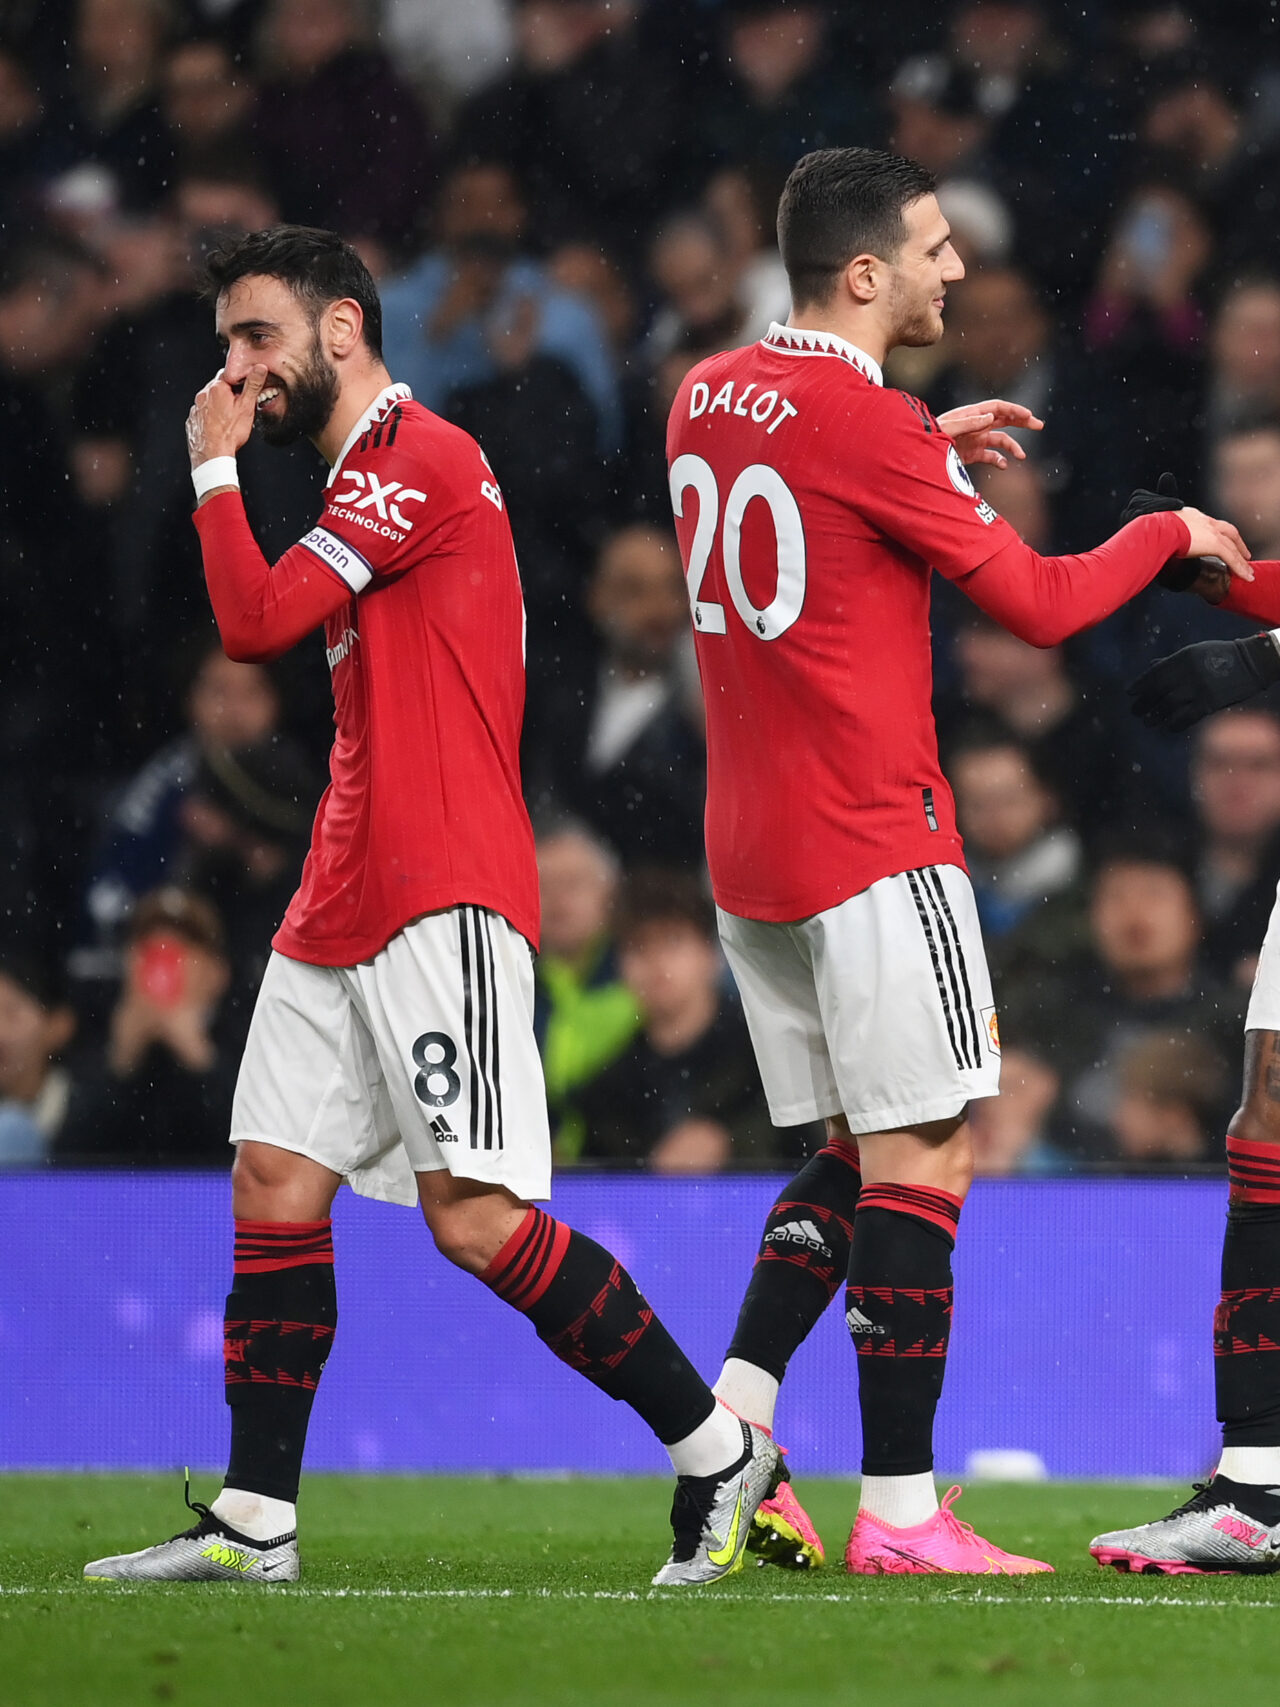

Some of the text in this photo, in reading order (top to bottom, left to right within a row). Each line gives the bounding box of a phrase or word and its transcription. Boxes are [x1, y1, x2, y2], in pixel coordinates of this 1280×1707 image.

[689, 381, 798, 434] DALOT
[327, 504, 406, 543] TECHNOLOGY
[334, 470, 428, 531] DXC
[669, 453, 807, 641] 20
[412, 1031, 461, 1108] 8
